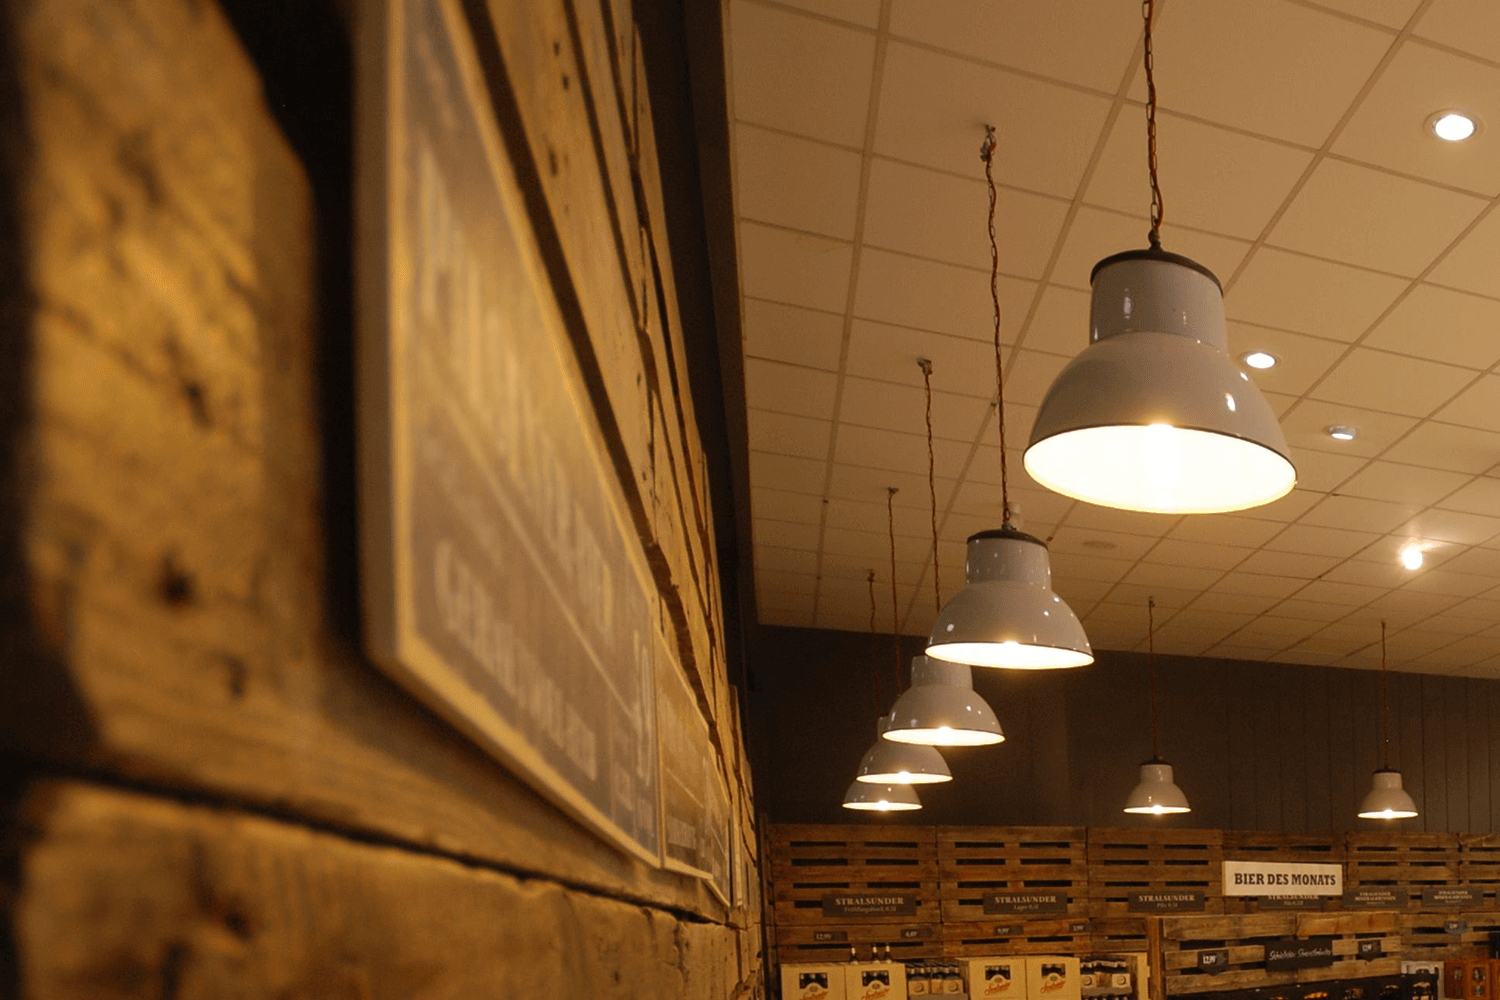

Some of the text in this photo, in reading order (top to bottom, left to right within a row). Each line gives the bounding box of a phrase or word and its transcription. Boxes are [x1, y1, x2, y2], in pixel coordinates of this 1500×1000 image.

[1234, 873, 1336, 886] BIER DES MONATS
[835, 898, 904, 906] STRALSUNDER
